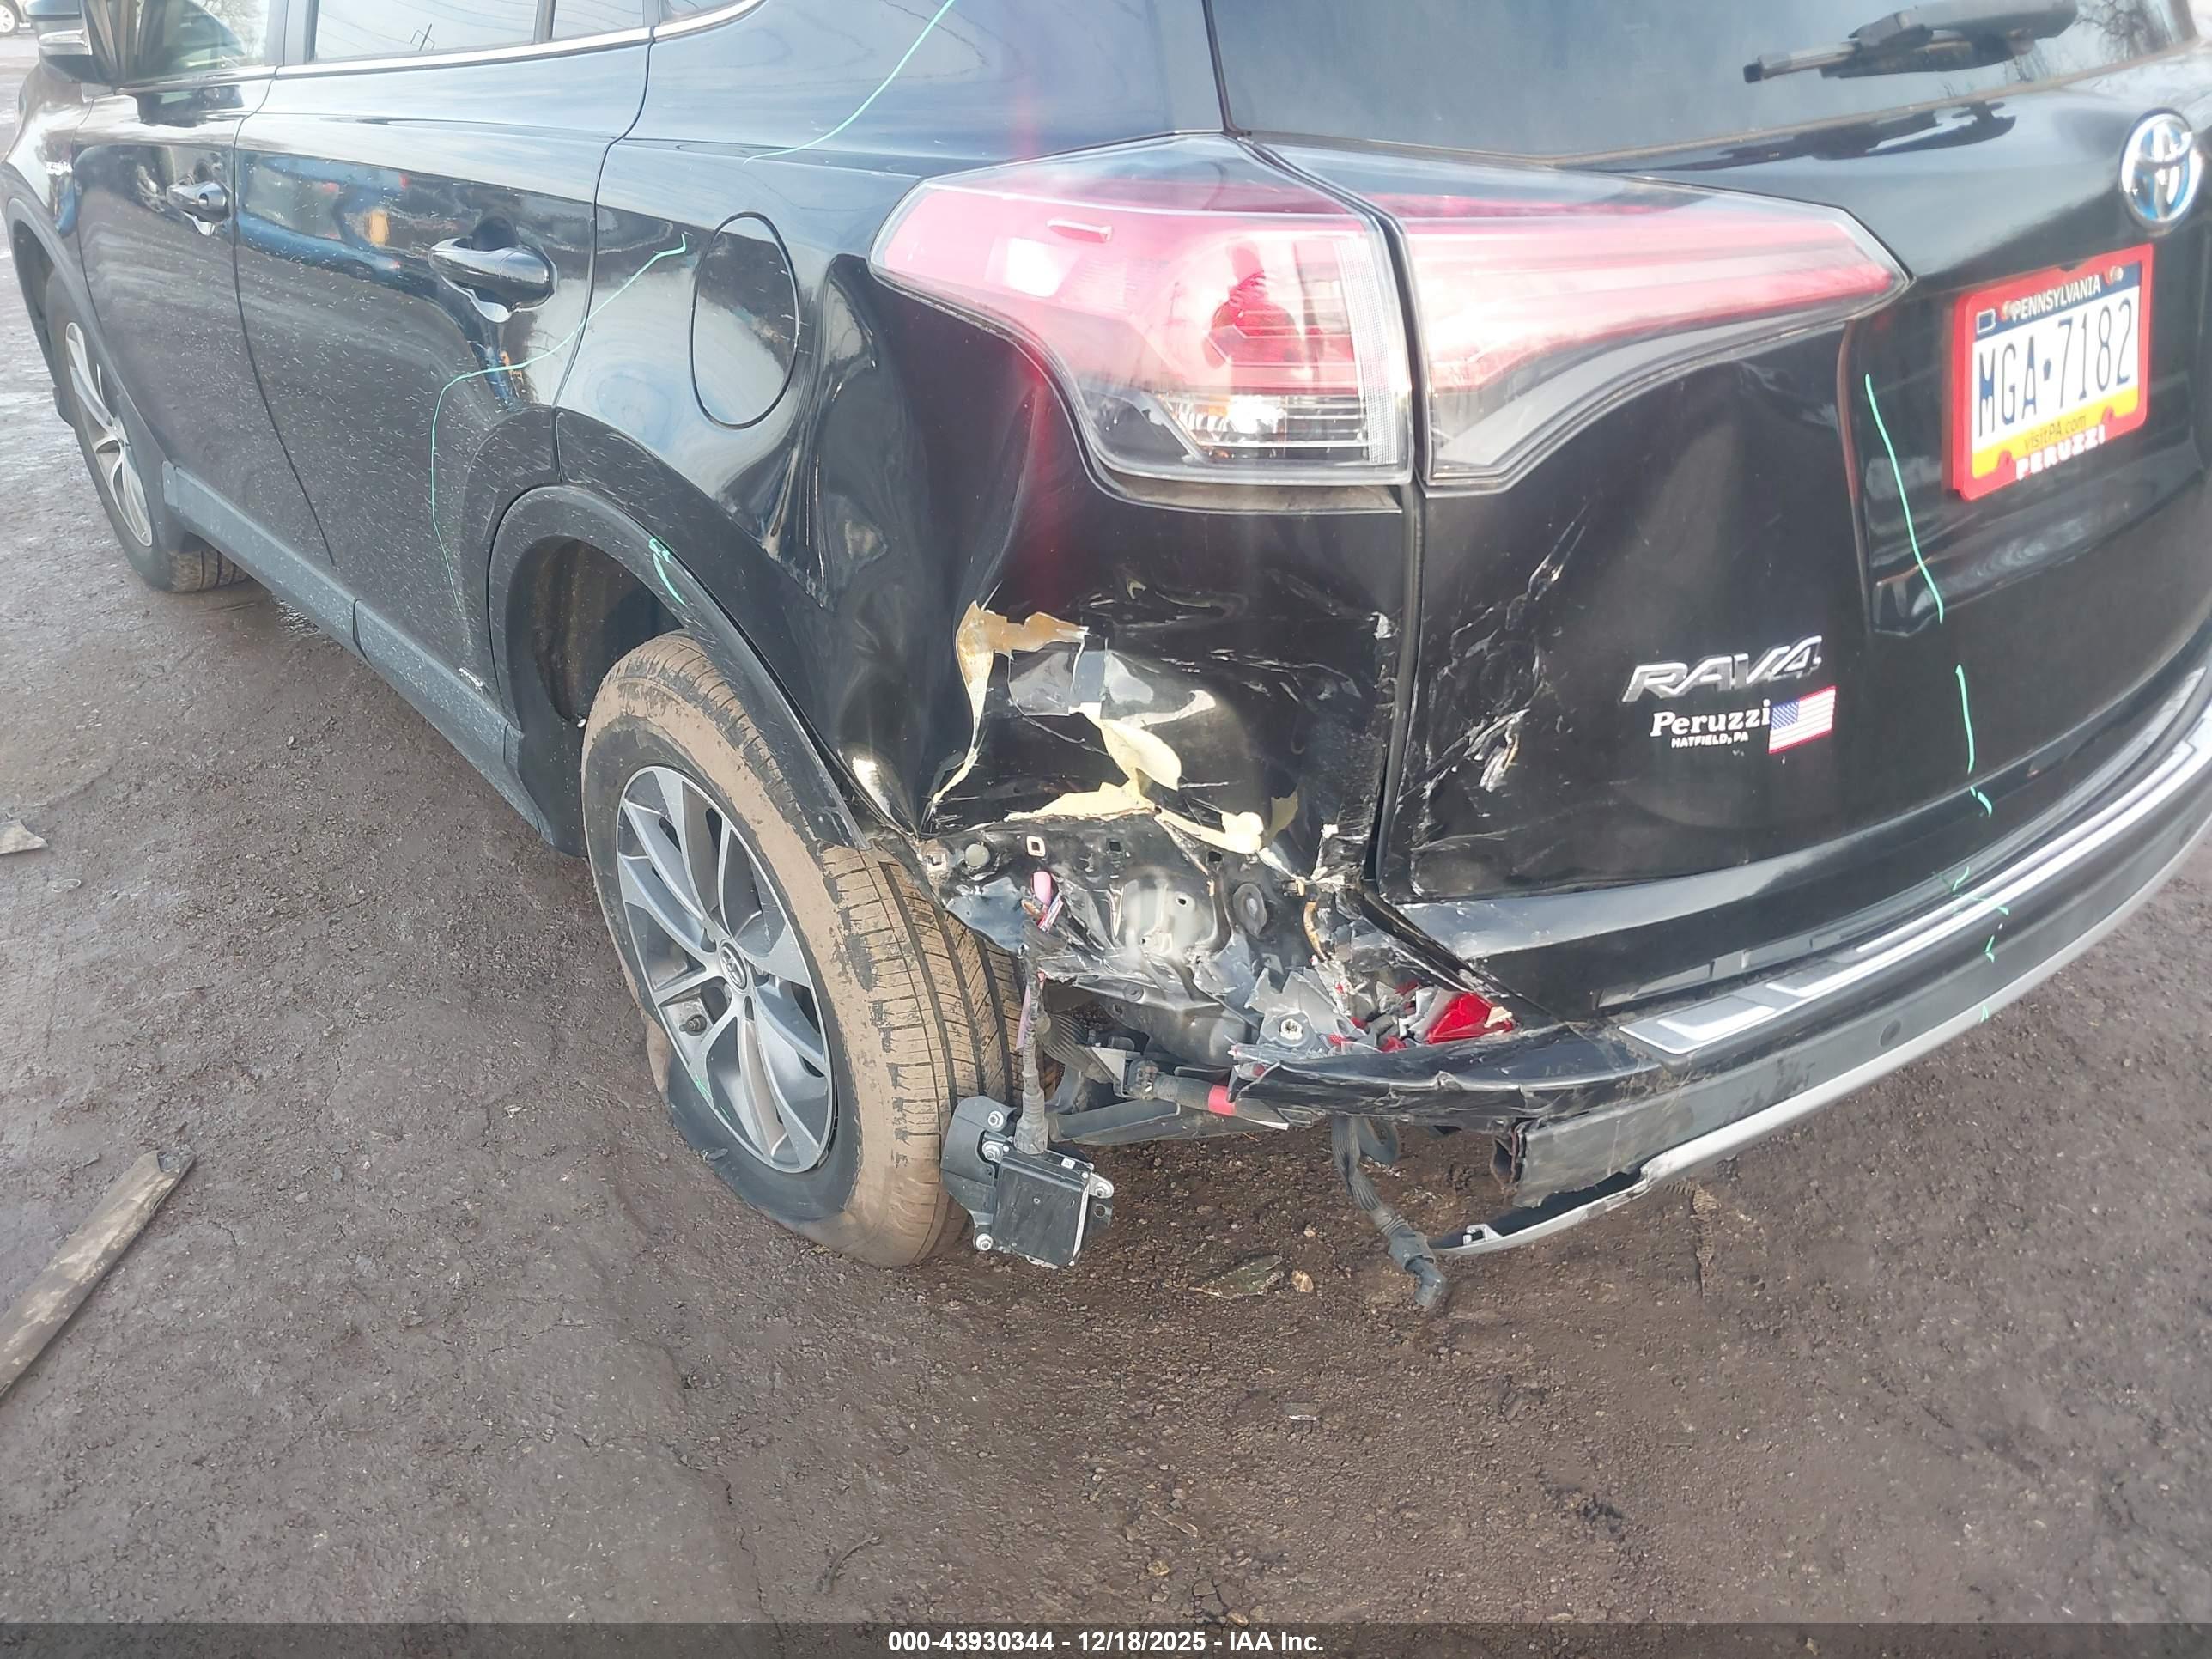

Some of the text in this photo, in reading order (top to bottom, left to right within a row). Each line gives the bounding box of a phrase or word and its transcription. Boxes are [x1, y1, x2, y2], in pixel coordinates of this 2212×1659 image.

[2010, 274, 2101, 323] PENNSYLVANIA
[2015, 424, 2106, 481] PERUZZI
[1650, 698, 1771, 737] Peruzzi
[1671, 731, 1749, 748] HATFIELD, PA
